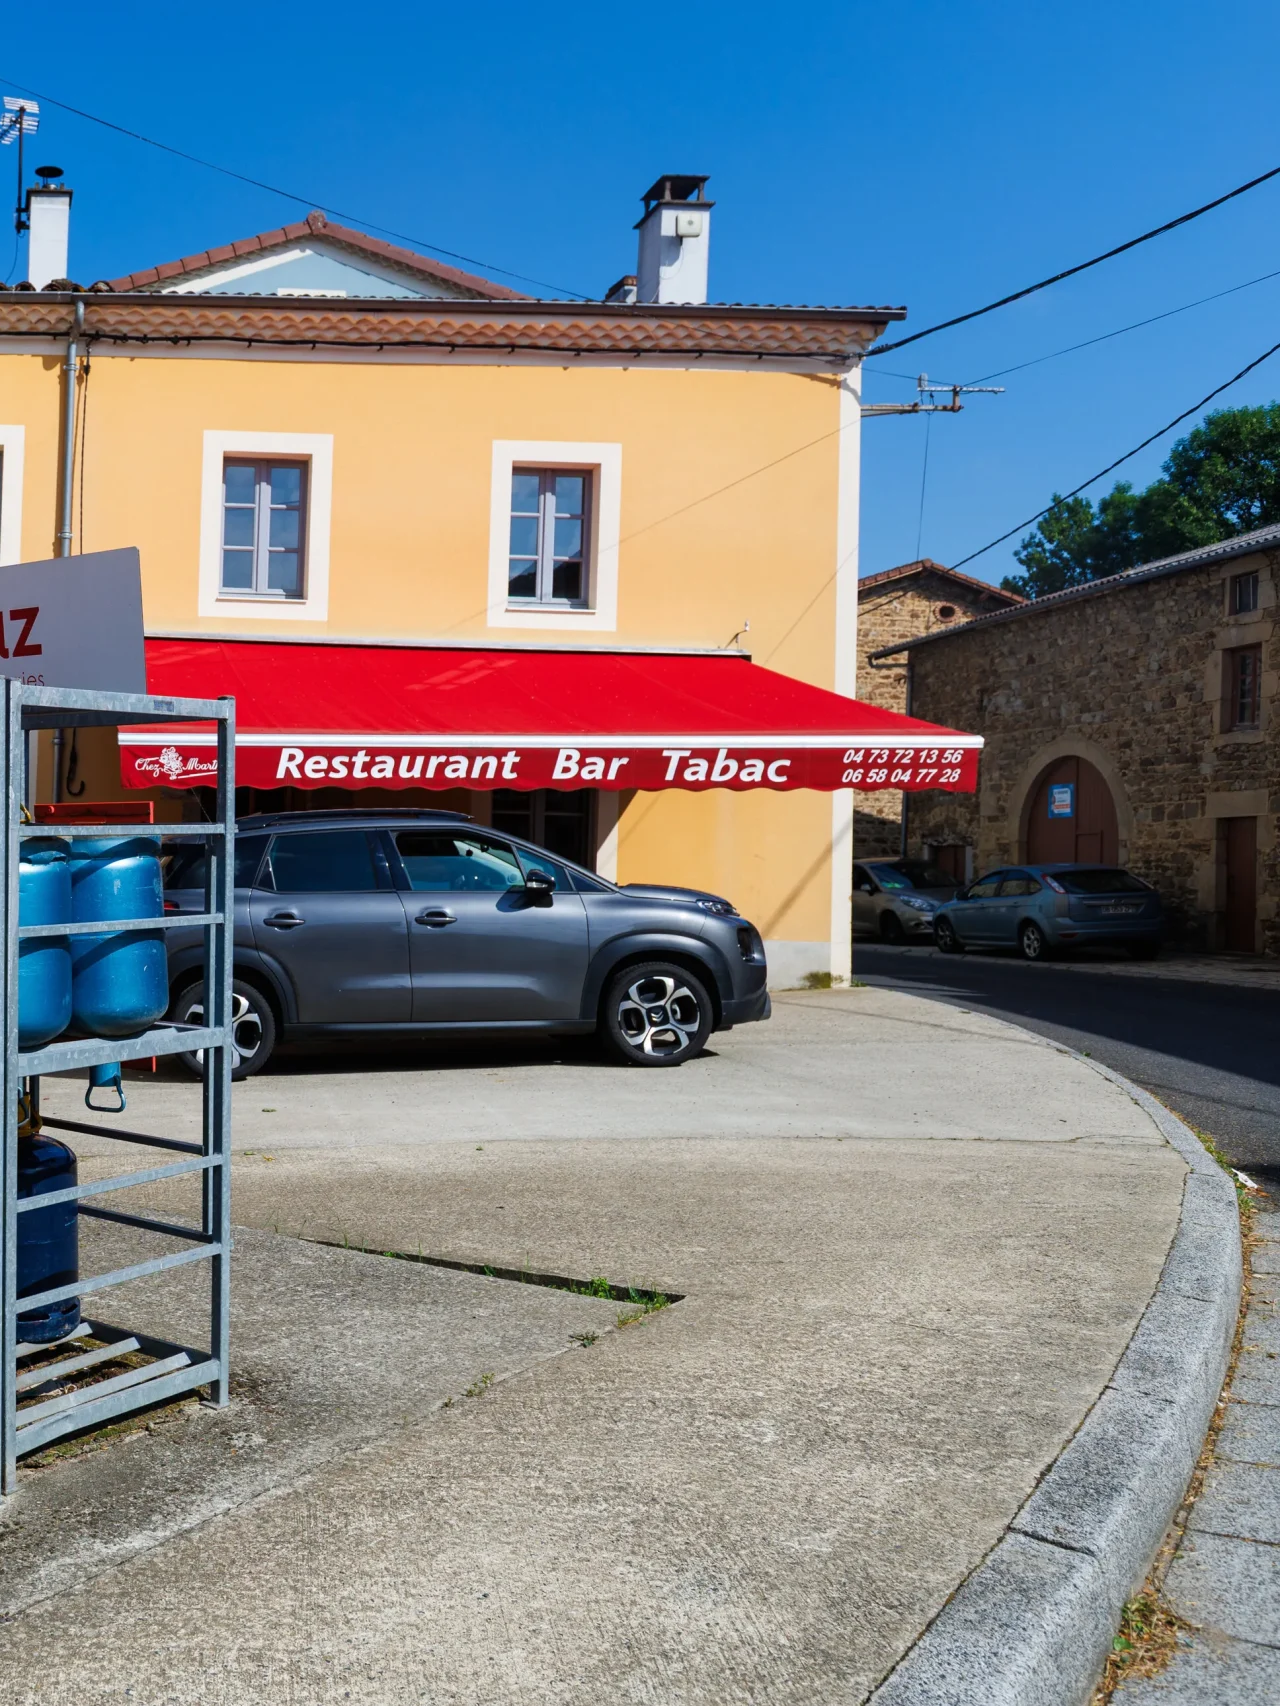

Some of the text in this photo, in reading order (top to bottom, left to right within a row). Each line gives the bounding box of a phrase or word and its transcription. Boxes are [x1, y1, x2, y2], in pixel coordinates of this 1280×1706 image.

[276, 747, 791, 783] Restaurant Bar Tabac
[843, 749, 964, 764] 04 73 72 13 56
[134, 757, 163, 777] Chez
[842, 768, 961, 783] 06 58 04 77 28
